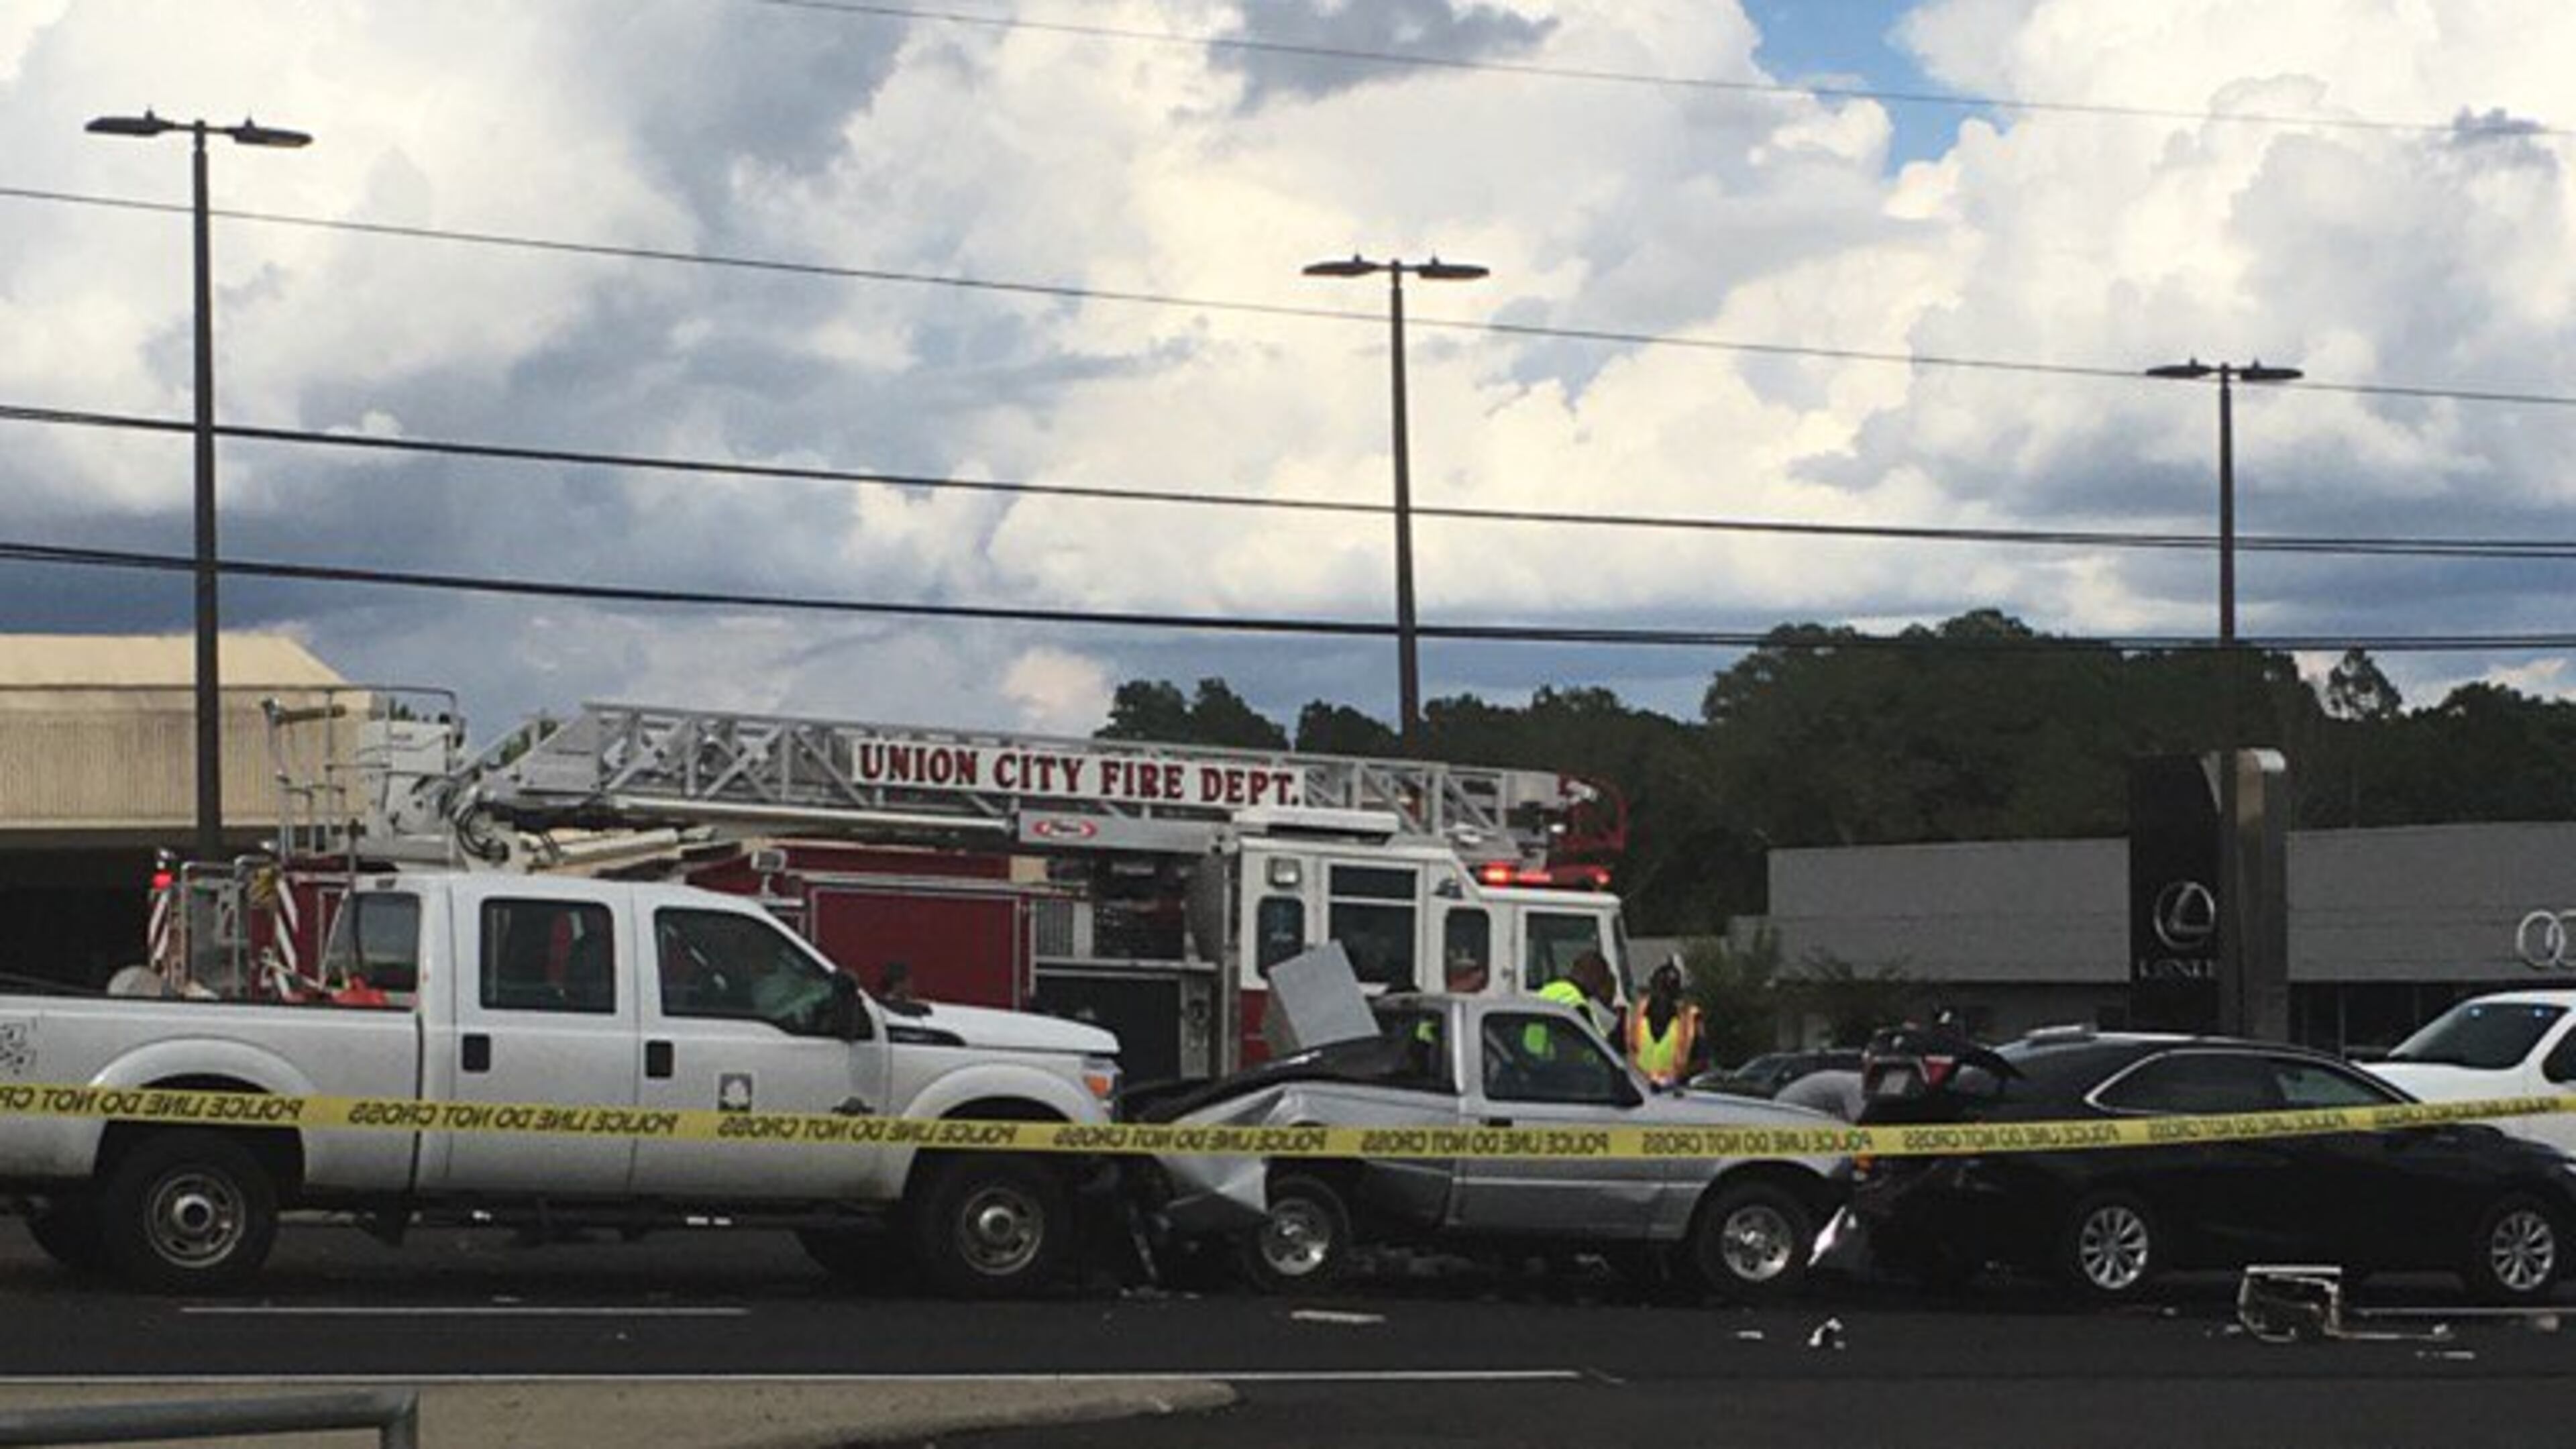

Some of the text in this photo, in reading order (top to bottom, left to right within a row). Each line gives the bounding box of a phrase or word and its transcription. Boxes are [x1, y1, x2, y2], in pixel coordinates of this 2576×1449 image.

[860, 743, 1299, 806] UNION CITY FIRE DEPT.
